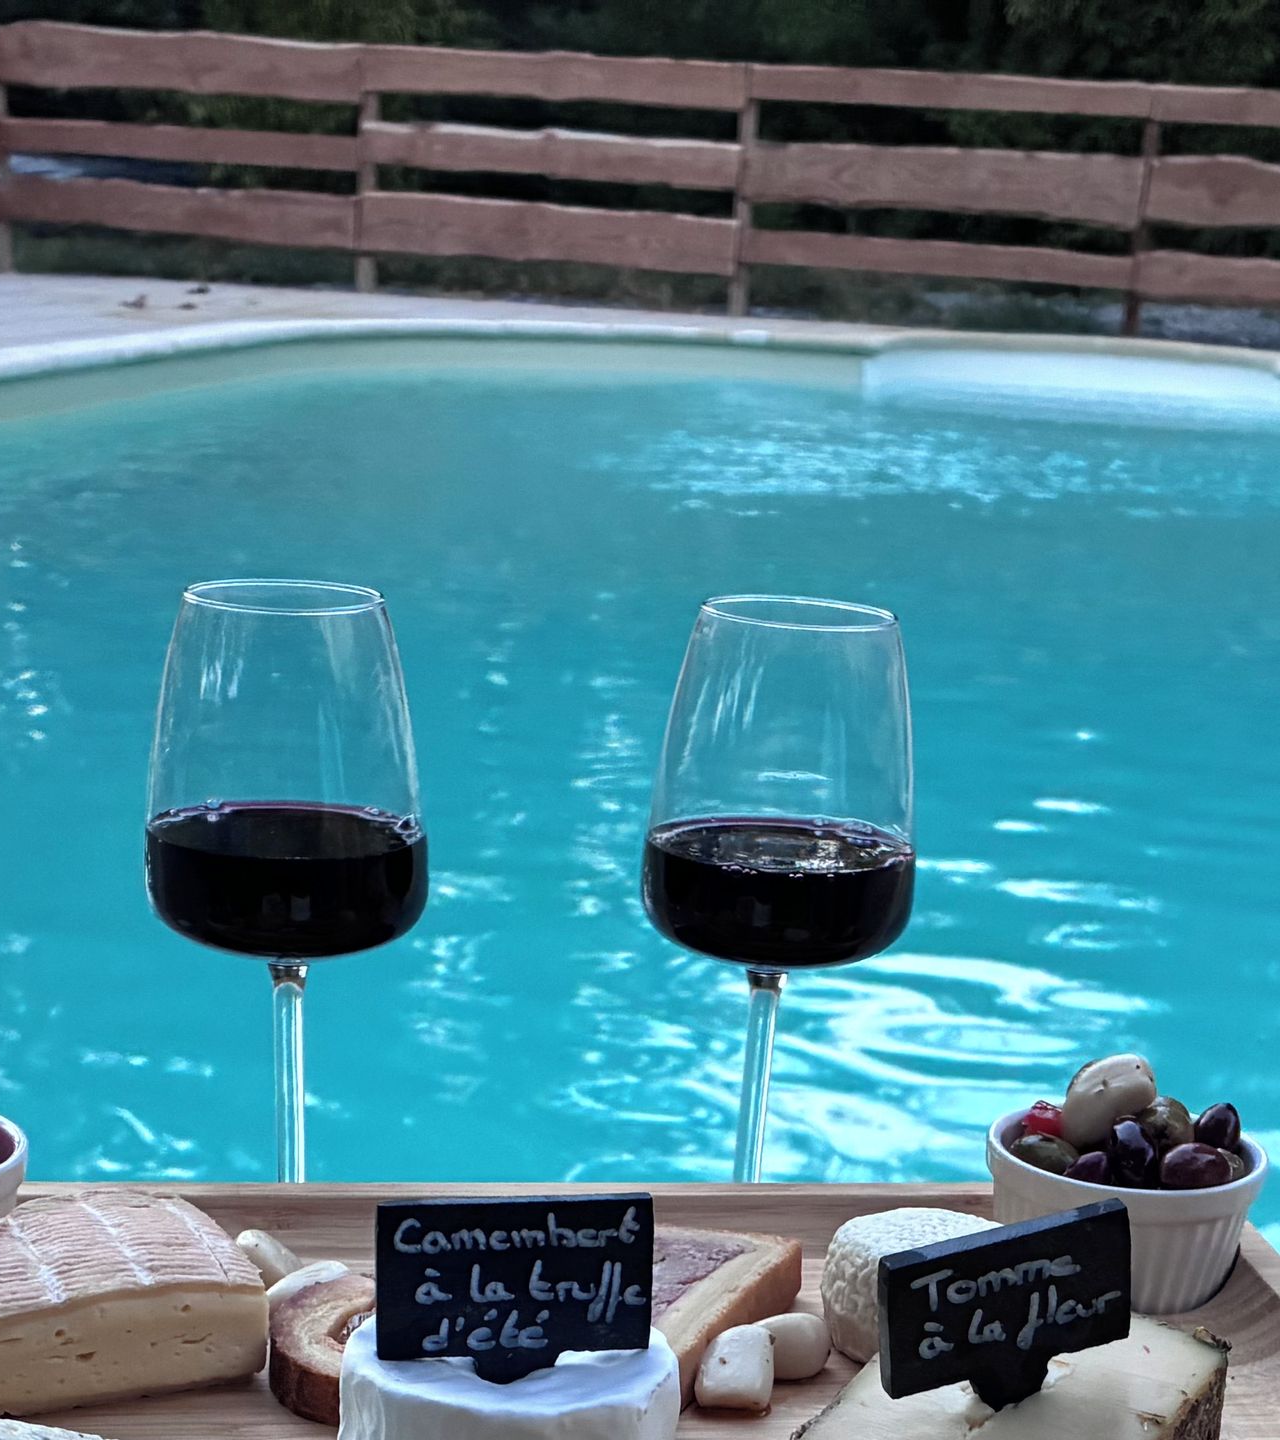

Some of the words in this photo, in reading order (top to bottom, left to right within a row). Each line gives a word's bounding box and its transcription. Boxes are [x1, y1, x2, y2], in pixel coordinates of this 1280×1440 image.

[393, 1205, 641, 1254] Camembert
[414, 1267, 453, 1305] à
[470, 1263, 515, 1303] la
[910, 1255, 1082, 1312] Tomme
[421, 1308, 549, 1352] d'été
[918, 1321, 955, 1360] à
[967, 1308, 1007, 1344] la
[1016, 1284, 1122, 1350] fleur
